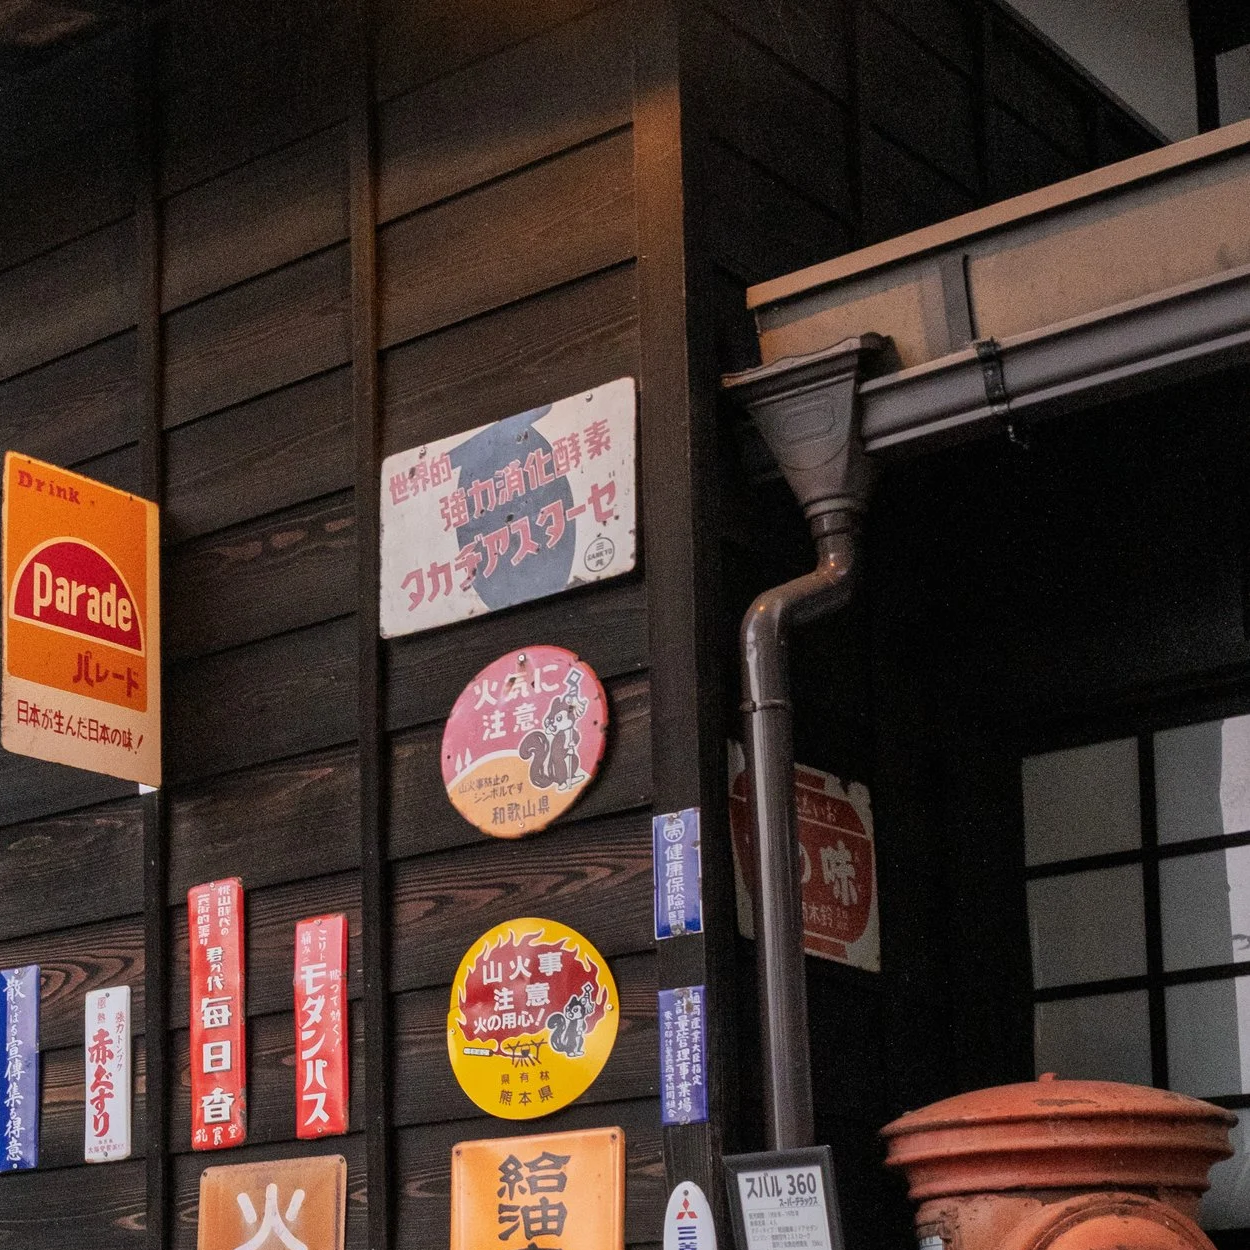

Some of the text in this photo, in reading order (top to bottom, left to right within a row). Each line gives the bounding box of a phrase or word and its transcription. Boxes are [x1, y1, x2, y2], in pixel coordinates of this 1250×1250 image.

[17, 470, 81, 505] Drink
[389, 452, 452, 506] 世界的
[439, 418, 612, 532] 強力消化酵素
[73, 650, 140, 698] パレード
[473, 664, 559, 711] 火気に
[17, 699, 144, 754] 日本が生んだ日本の味!
[482, 702, 539, 741] 注意
[491, 795, 550, 825] 和歌山県
[481, 951, 564, 986] 山火事
[493, 982, 550, 1012] 注意
[473, 1007, 545, 1035] 火の用心!
[201, 996, 234, 1124] 毎日香
[300, 961, 330, 1127] モダンパス
[88, 1028, 115, 1138] 赤ぐすり
[499, 1085, 554, 1107] 熊本県
[500, 1070, 550, 1086] 県有林
[745, 1172, 817, 1199] スバル 360
